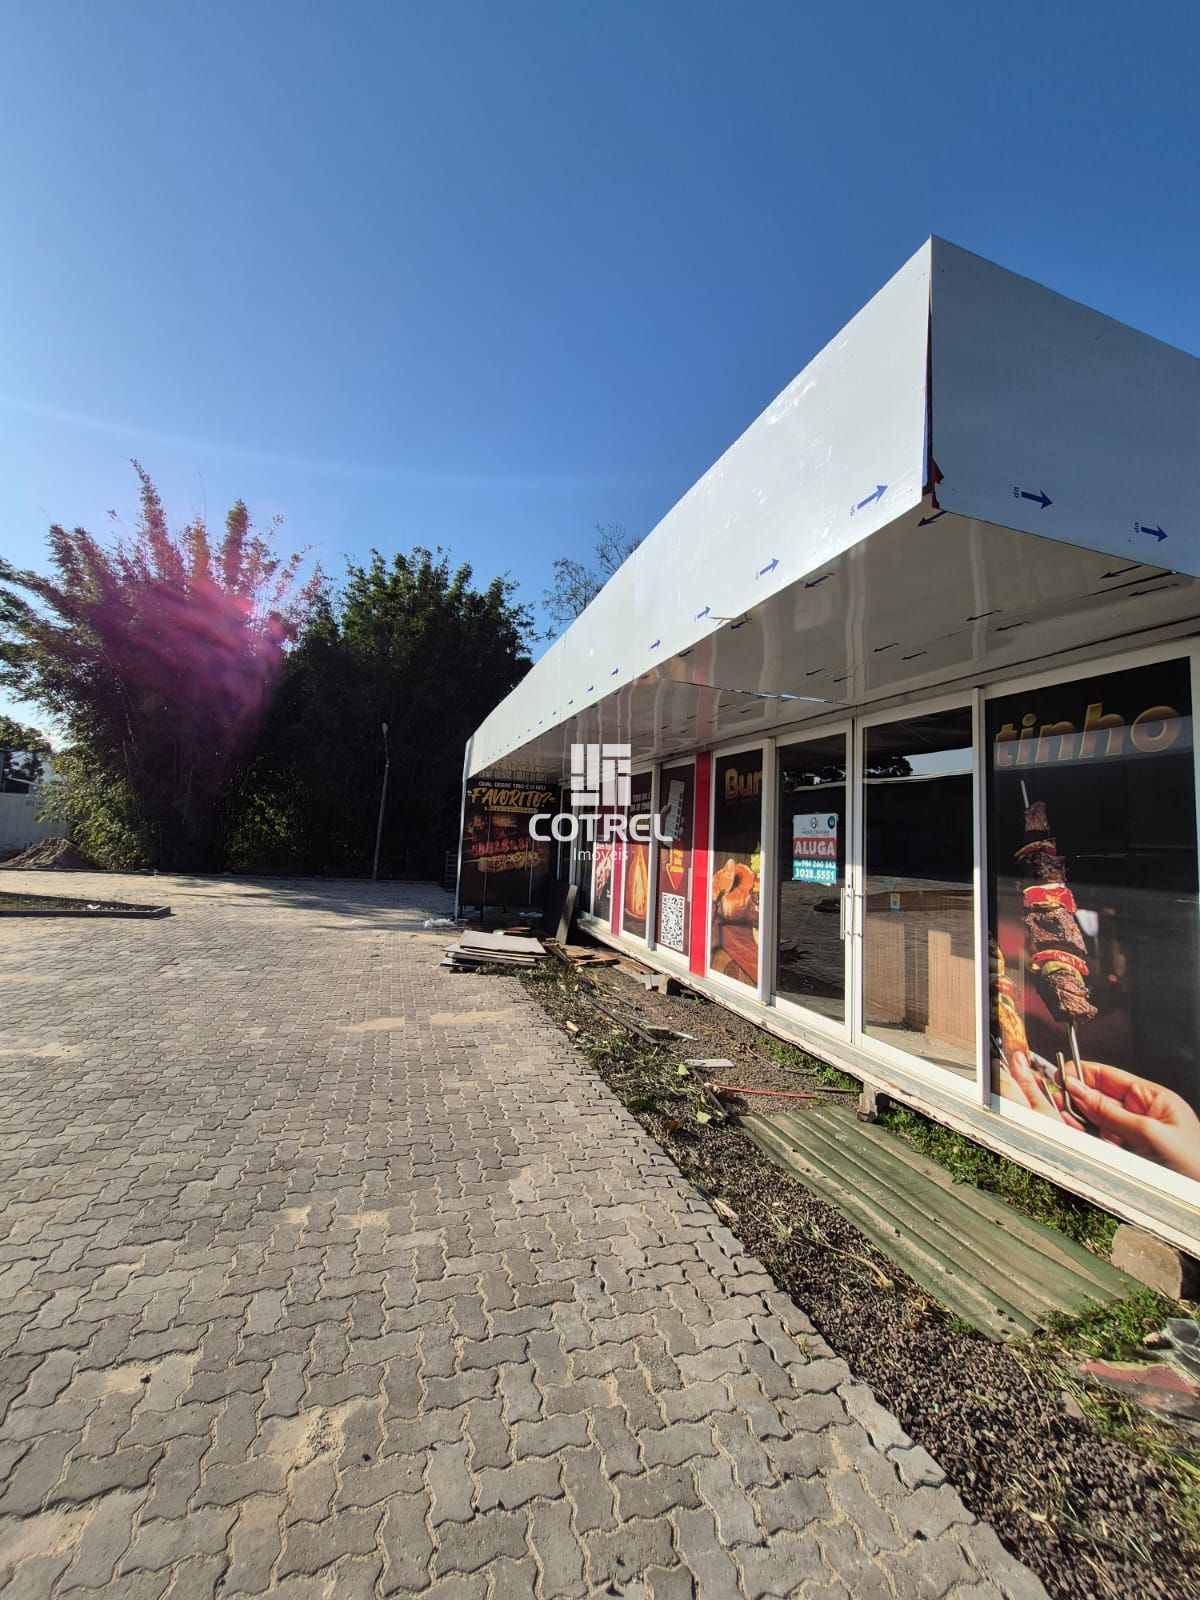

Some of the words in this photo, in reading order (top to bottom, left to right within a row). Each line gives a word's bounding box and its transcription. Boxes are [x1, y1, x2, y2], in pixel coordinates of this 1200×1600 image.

[995, 702, 1181, 767] tinho
[725, 768, 762, 800] Bur
[470, 787, 553, 808] FAVORITO?
[794, 841, 835, 856] ALUGA
